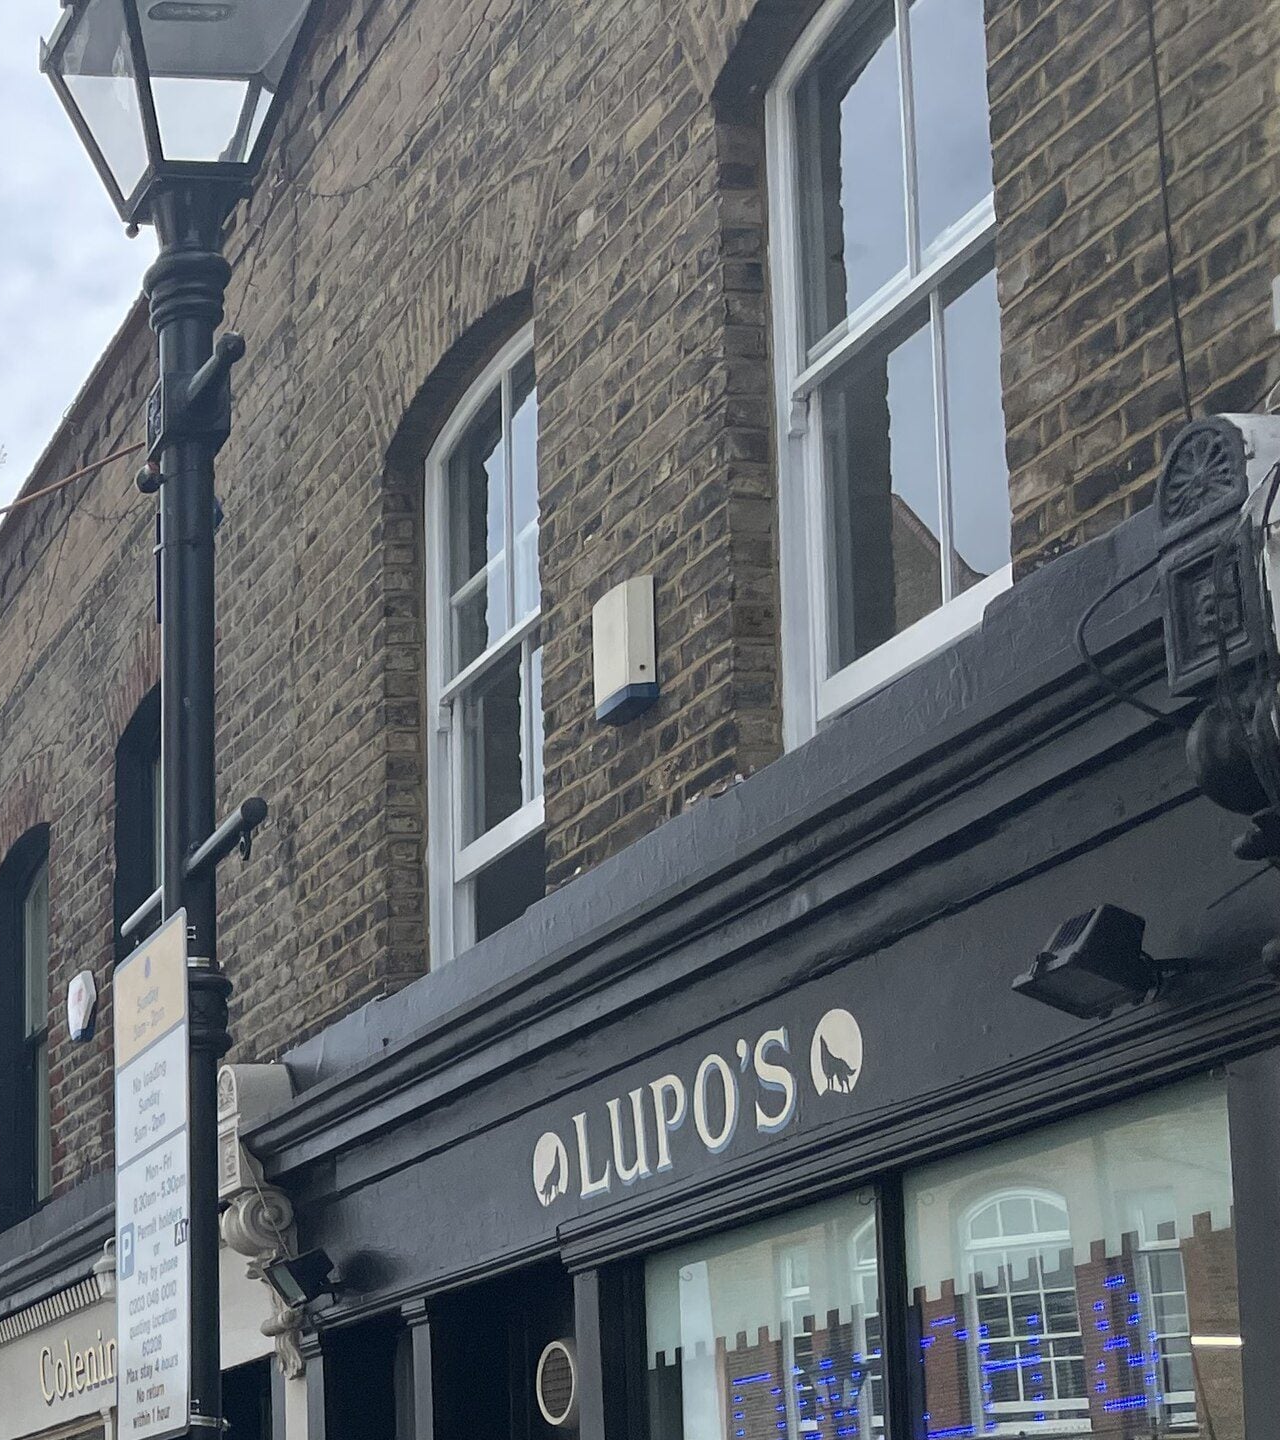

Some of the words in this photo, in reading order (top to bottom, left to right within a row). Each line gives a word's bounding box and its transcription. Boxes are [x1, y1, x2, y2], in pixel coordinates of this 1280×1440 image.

[133, 1077, 140, 1094] No
[143, 1060, 167, 1087] loading
[138, 1090, 160, 1114] Sunday
[572, 1026, 797, 1200] LUPO'S
[145, 1164, 158, 1181] Mon
[163, 1152, 172, 1167] Fri
[137, 1217, 157, 1241] Permit
[159, 1206, 182, 1231] holders
[121, 1231, 132, 1274] P
[153, 1242, 160, 1256] or
[138, 1269, 148, 1286] Pay
[150, 1265, 157, 1281] by
[160, 1256, 178, 1275] phone
[130, 1318, 151, 1340] quoting
[152, 1308, 177, 1329] location
[126, 1368, 138, 1384] Max
[140, 1363, 153, 1380] stay
[154, 1357, 160, 1372] 4
[161, 1354, 178, 1371] hours
[137, 1388, 145, 1403] No
[146, 1383, 164, 1400] return
[133, 1410, 150, 1429] within
[156, 1406, 171, 1422] hour
